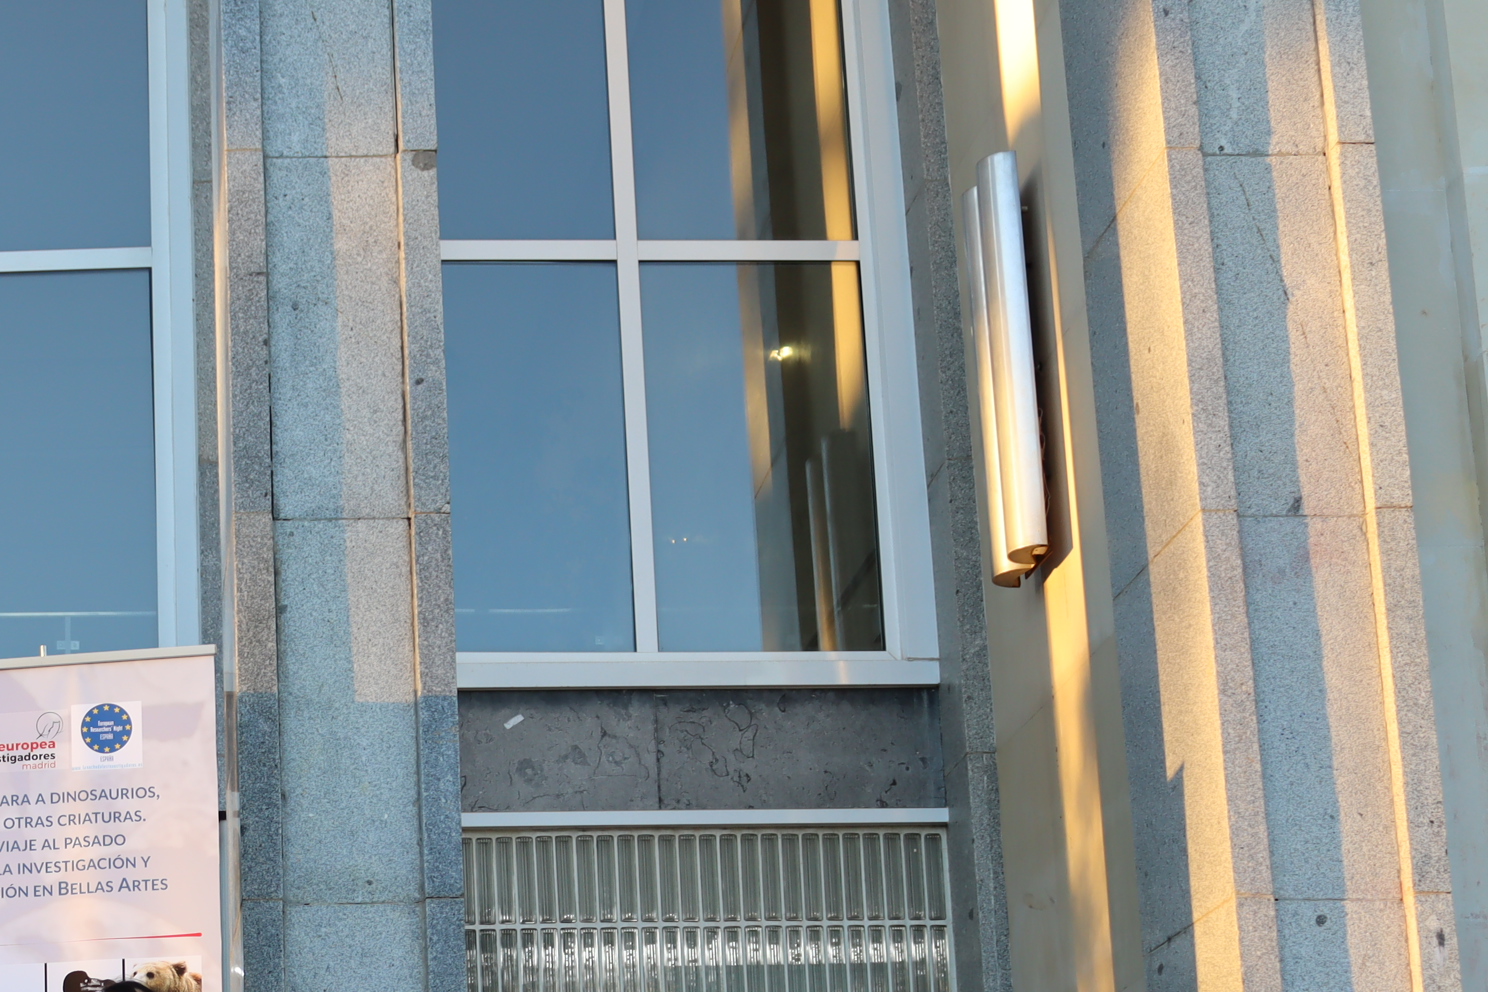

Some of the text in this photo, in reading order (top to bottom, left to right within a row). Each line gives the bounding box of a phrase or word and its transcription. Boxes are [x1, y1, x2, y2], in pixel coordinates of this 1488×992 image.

[22, 761, 56, 770] madrid
[35, 793, 46, 805] A
[50, 786, 160, 805] DINOSAURIOS,
[3, 815, 54, 830] OTRAS
[57, 810, 146, 826] CRIATURAS.
[41, 838, 60, 851] AL
[64, 834, 126, 849] PASADO
[17, 854, 137, 875] INVESTIGACIÓN
[140, 856, 151, 868] Y
[33, 884, 53, 898] EN
[58, 880, 114, 896] BELLAS
[118, 877, 168, 892] ARTES
